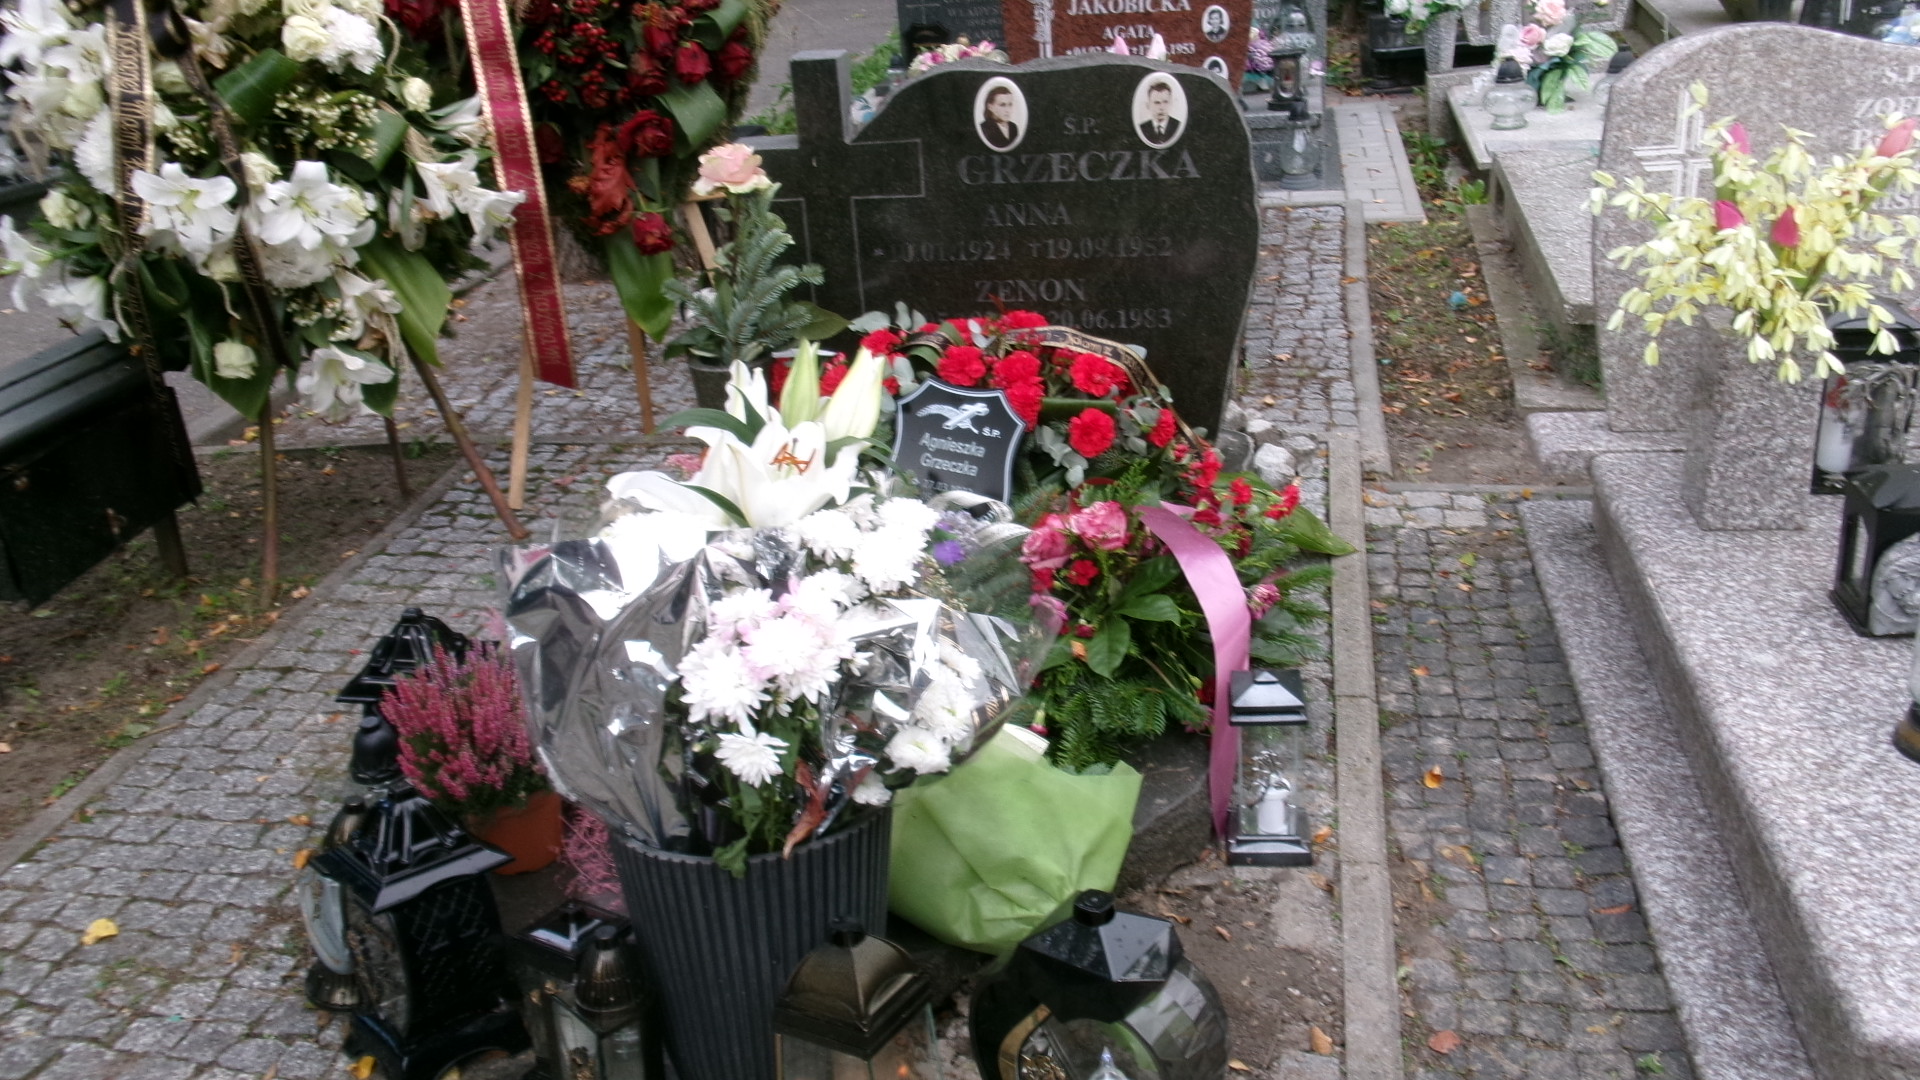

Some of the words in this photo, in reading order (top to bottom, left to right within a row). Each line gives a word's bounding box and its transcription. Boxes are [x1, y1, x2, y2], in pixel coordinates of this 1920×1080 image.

[1102, 25, 1155, 39] AGATA
[957, 149, 1201, 186] GRZECZKA
[985, 202, 1073, 227] ANNA
[974, 279, 1086, 303] ZENON
[918, 432, 986, 458] Agnieszka
[920, 452, 979, 477] Grzeczka
